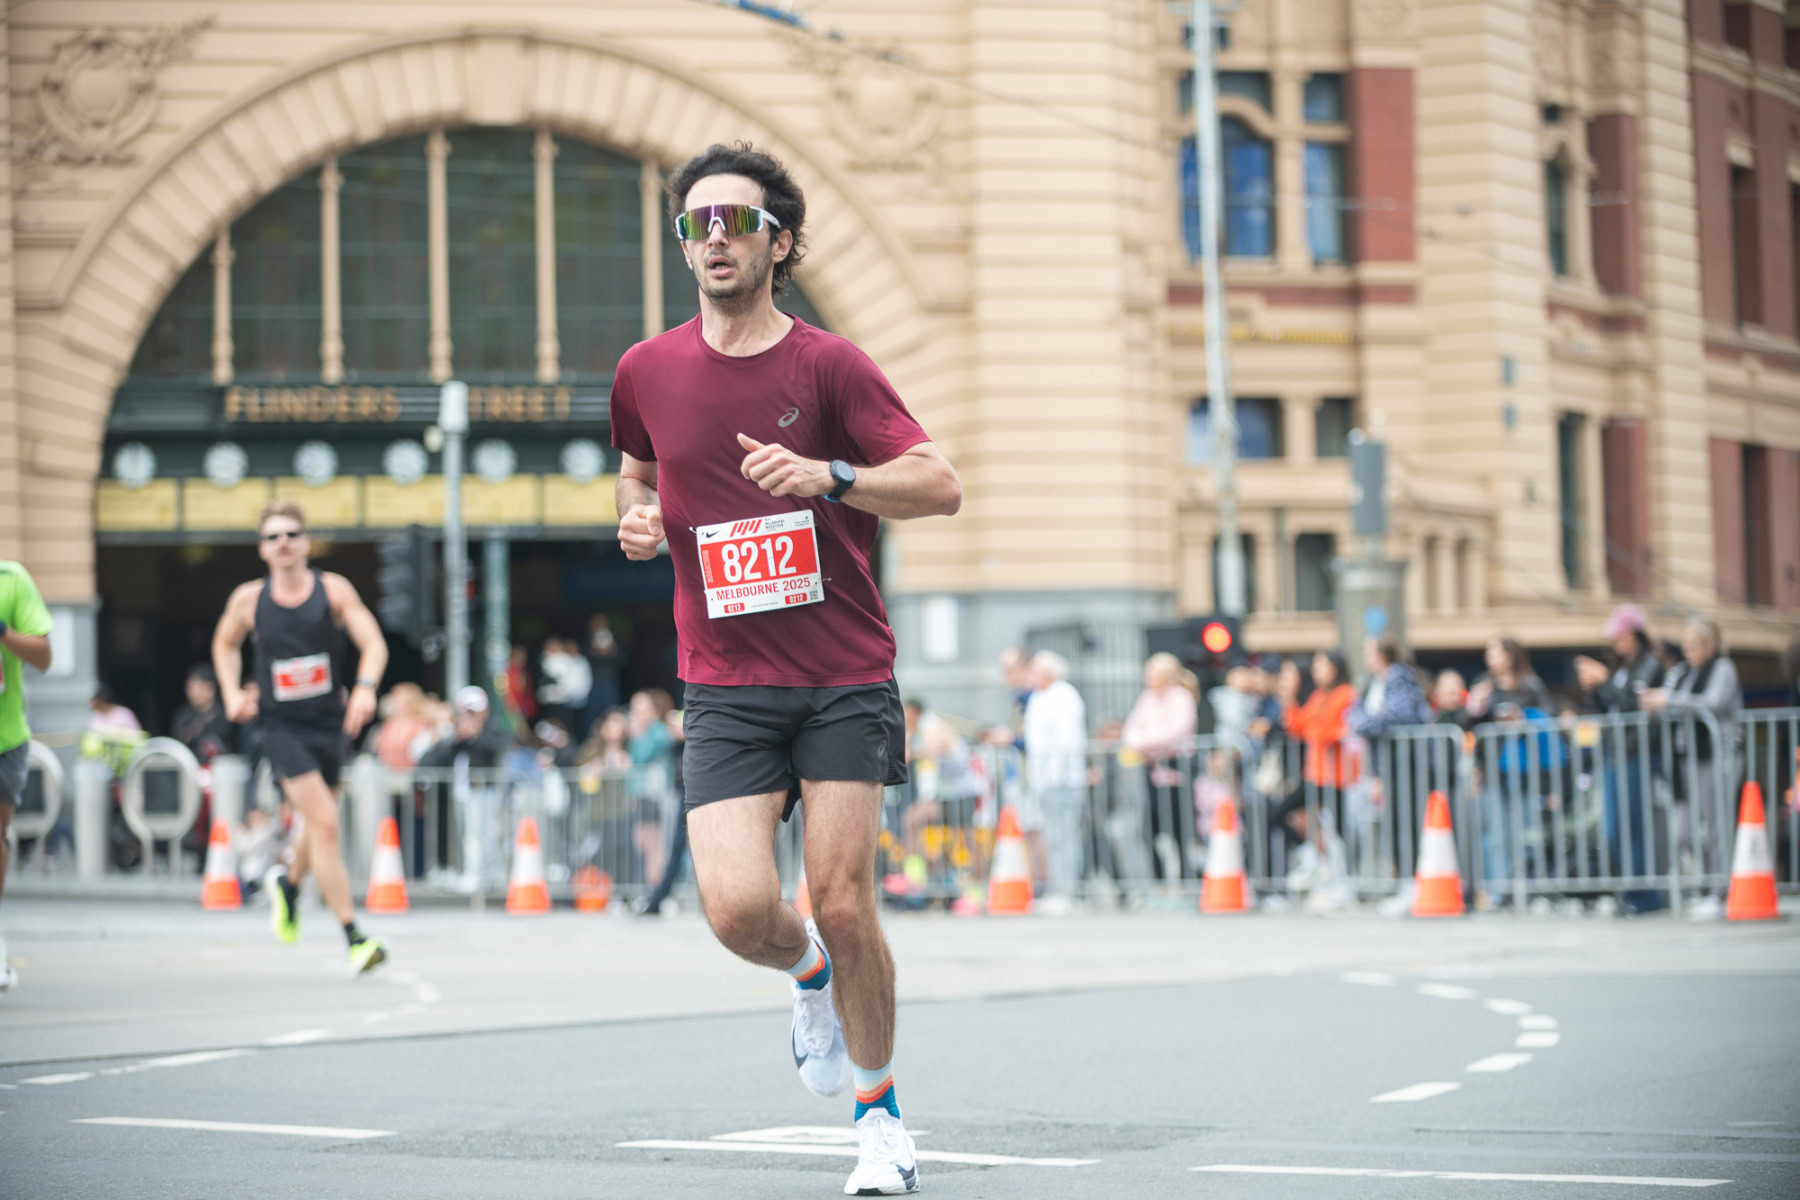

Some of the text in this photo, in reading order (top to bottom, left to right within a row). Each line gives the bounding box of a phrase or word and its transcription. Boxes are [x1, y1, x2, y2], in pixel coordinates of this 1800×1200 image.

[225, 386, 575, 422] FLINDERS TREET
[721, 536, 797, 583] 8212
[716, 577, 811, 600] MELBOURNE 2025
[789, 594, 804, 603] 8212
[727, 602, 742, 612] 8212
